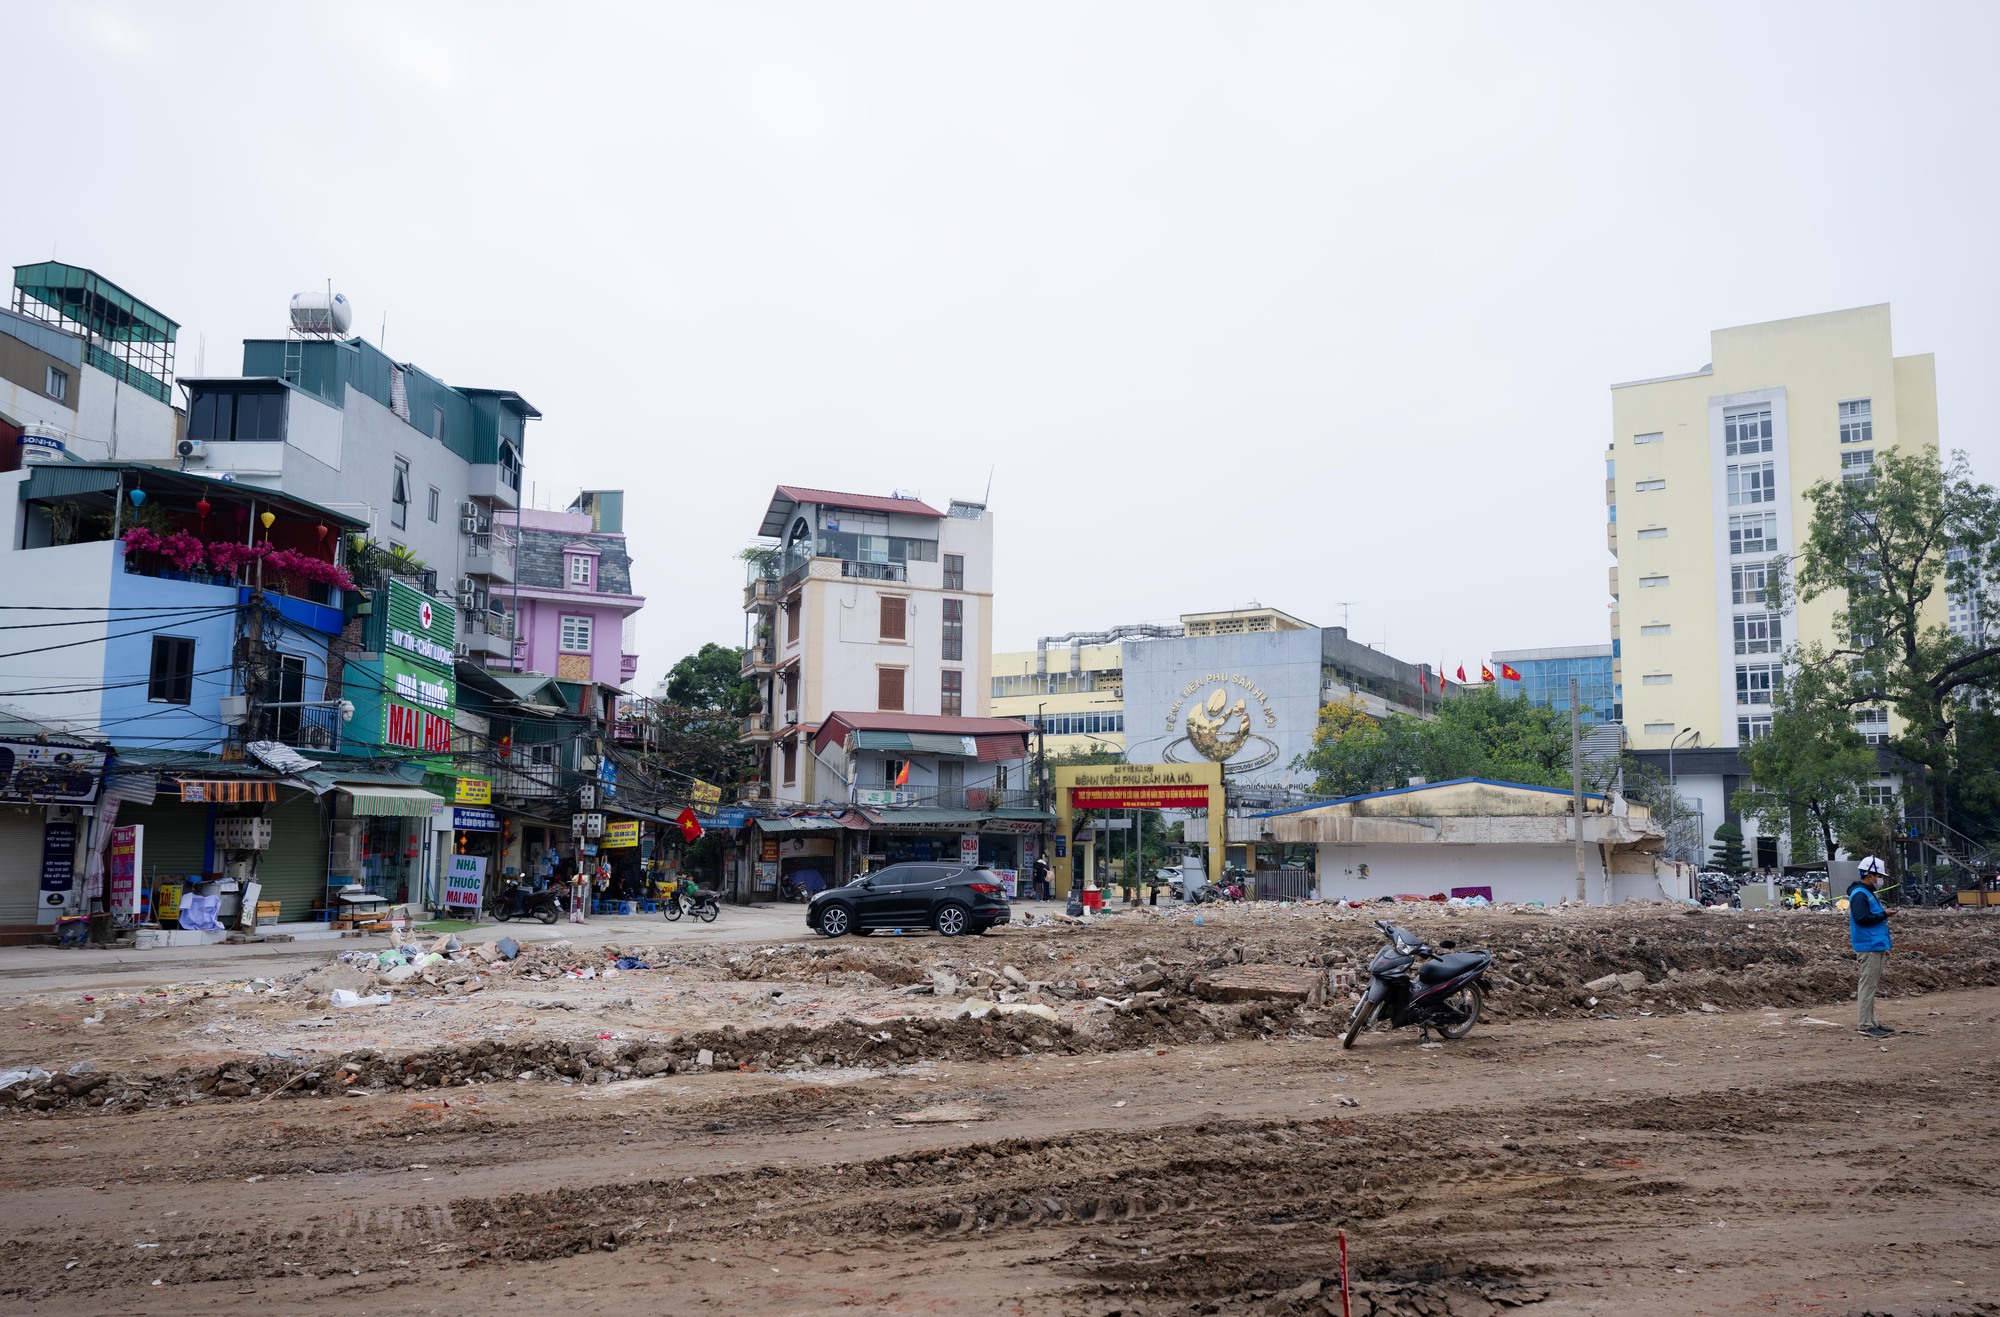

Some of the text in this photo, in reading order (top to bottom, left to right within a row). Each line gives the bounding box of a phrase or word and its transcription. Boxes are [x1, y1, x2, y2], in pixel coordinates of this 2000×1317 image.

[392, 629, 403, 647] UY
[402, 630, 415, 651] TÍN
[417, 638, 433, 658] CHẤT
[395, 673, 449, 711] NHÀ THUỐC
[1165, 672, 1278, 732] BỆNH VIỆN PHỤ SẢN HÀ NỘI
[386, 702, 452, 754] MAI HOA
[1075, 772, 1193, 786] BỆNH VIỆN PHỤ SẢN HÀ NỘI
[961, 836, 977, 851] CHÁO
[456, 857, 477, 872] NHÀ
[449, 874, 480, 890] THUỐC
[446, 890, 478, 905] MAI HOA
